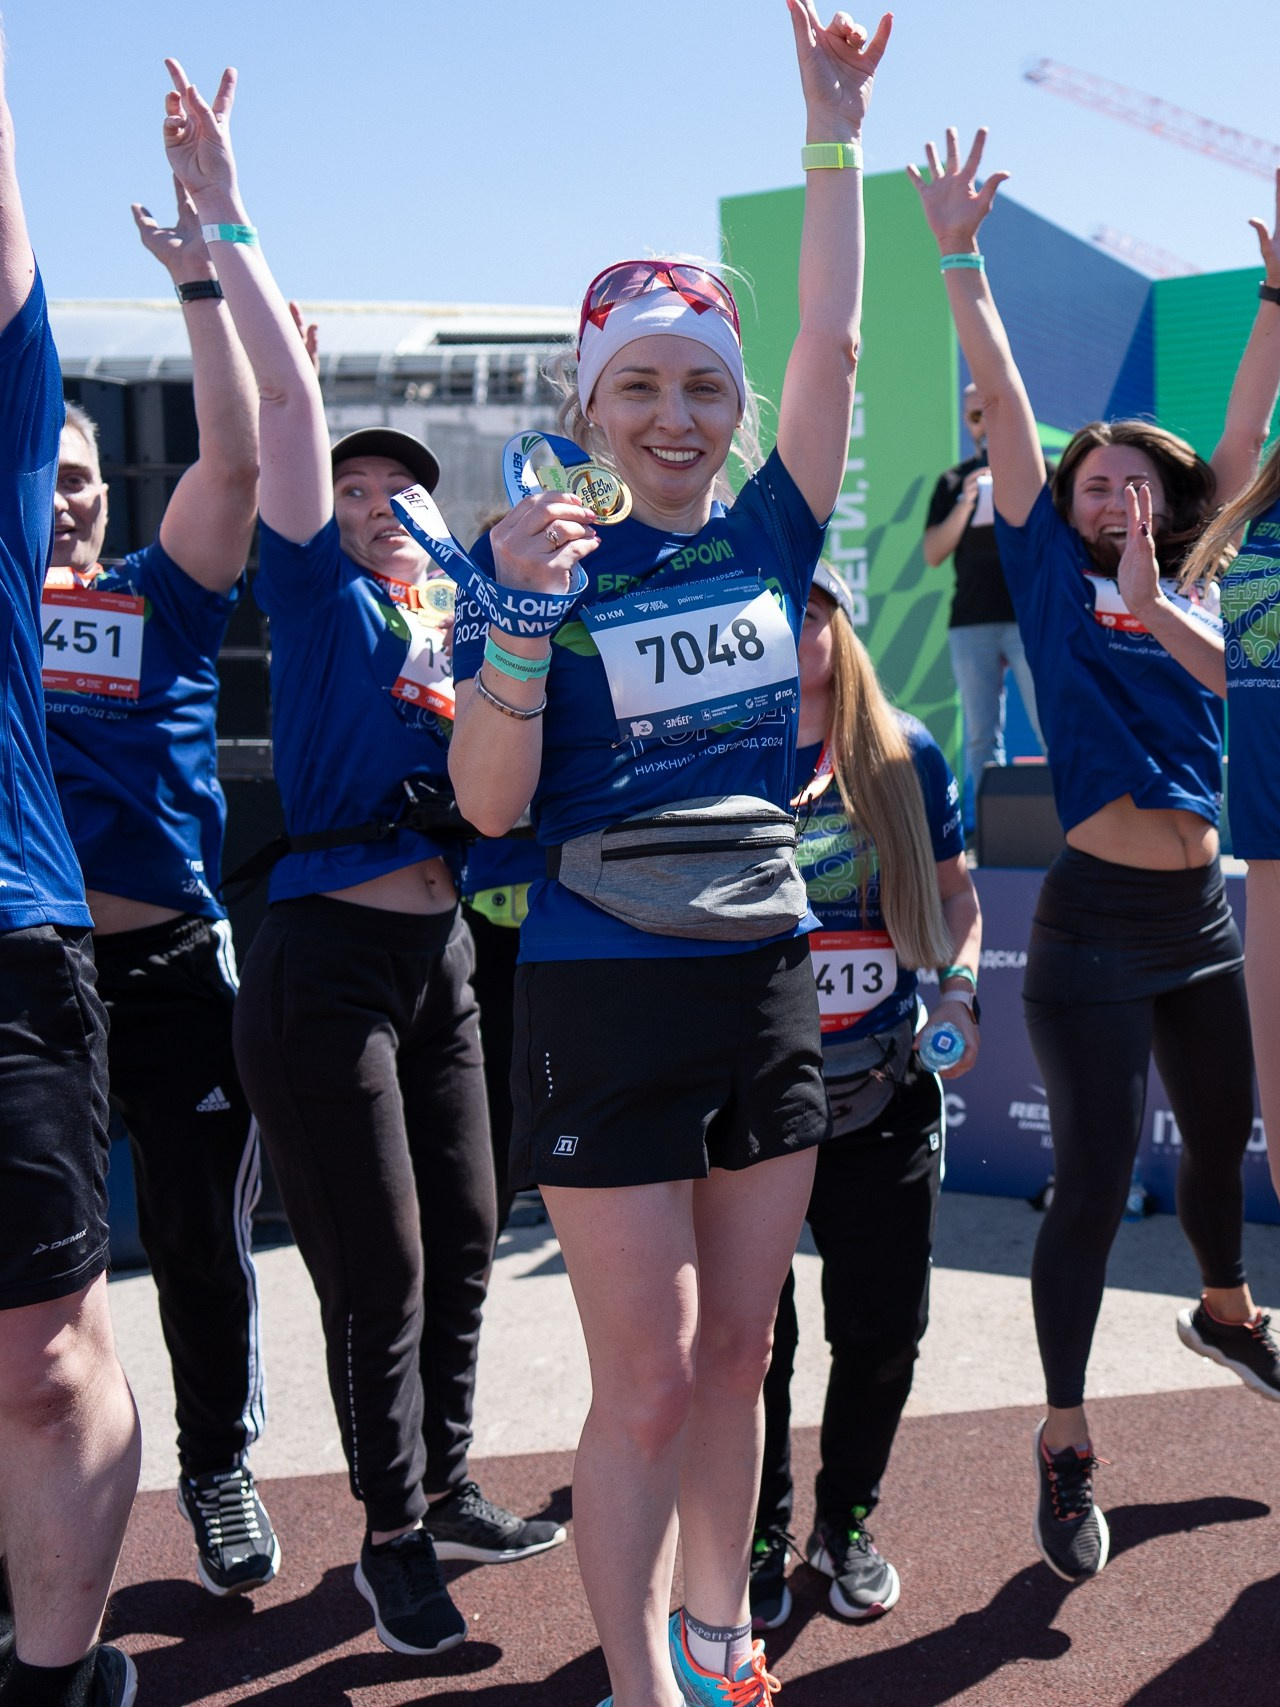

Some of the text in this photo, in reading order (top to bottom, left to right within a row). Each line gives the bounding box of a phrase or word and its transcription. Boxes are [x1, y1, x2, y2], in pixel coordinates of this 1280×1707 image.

[670, 537, 735, 571] ЕРОЙ!
[594, 613, 606, 622] 10
[43, 618, 122, 658] 451
[456, 621, 489, 645] 2024
[635, 618, 765, 685] 7048
[44, 702, 104, 718] ОВГОРОД
[761, 737, 783, 748] 2024
[813, 908, 857, 918] ГОРОД
[815, 962, 883, 996] 413
[50, 1228, 88, 1251] DEMIX
